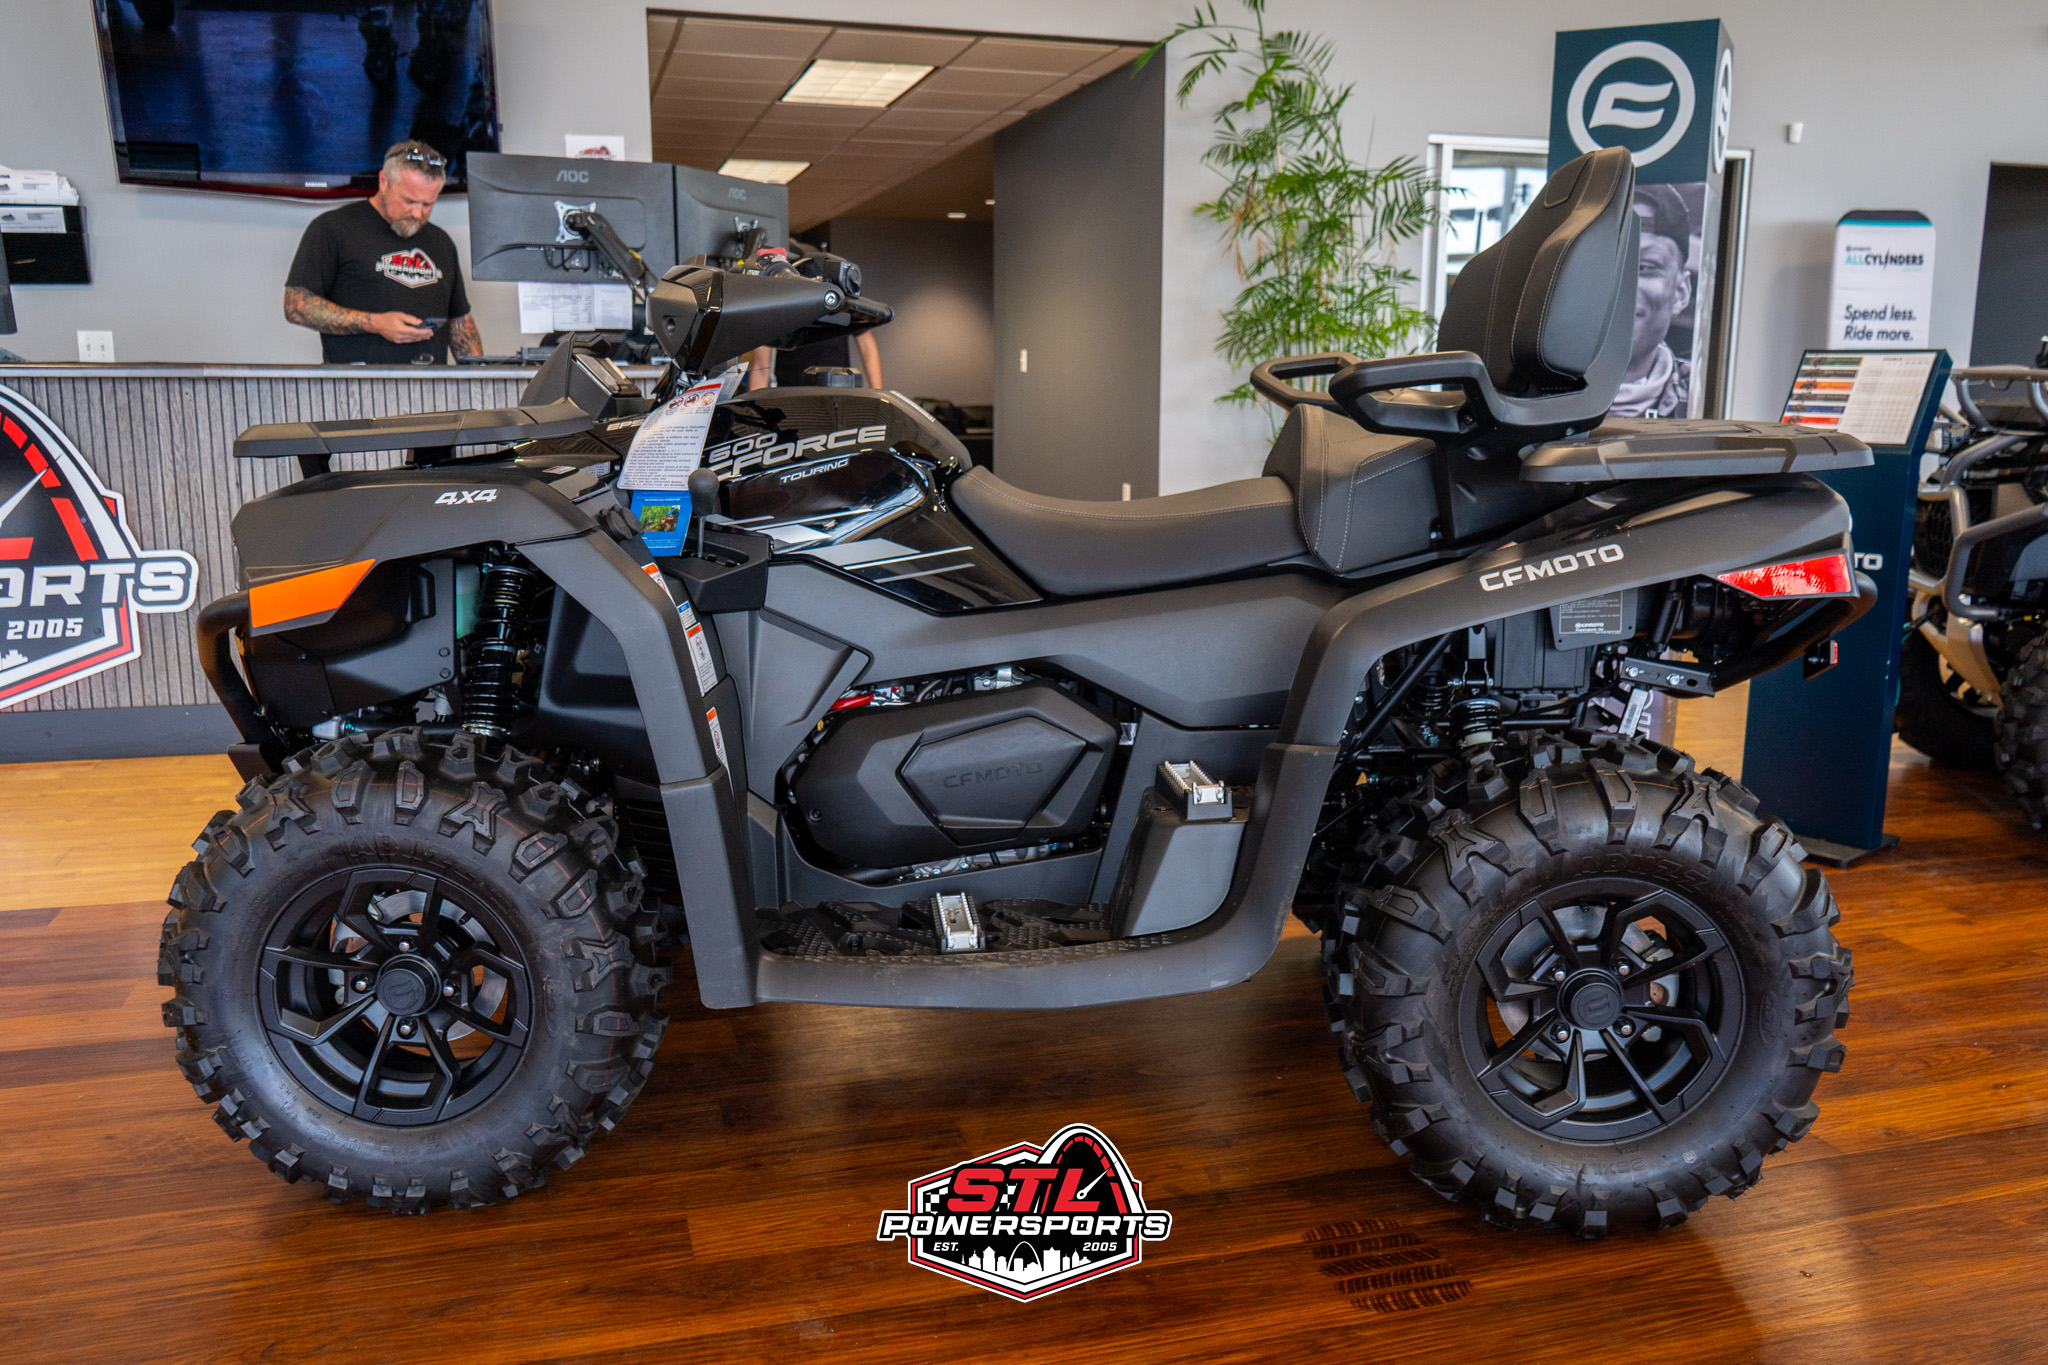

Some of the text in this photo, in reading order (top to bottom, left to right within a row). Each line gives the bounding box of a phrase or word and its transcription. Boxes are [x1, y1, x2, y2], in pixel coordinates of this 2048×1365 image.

[556, 169, 589, 183] AOC
[392, 254, 426, 269] STL
[1844, 303, 1916, 324] Spend less.
[1844, 324, 1914, 341] Ride more.
[708, 432, 778, 464] 600
[779, 458, 849, 483] TOURING
[1480, 543, 1624, 592] CFMOTO
[6, 617, 84, 640] 2005
[943, 762, 1043, 789] CFMOTO
